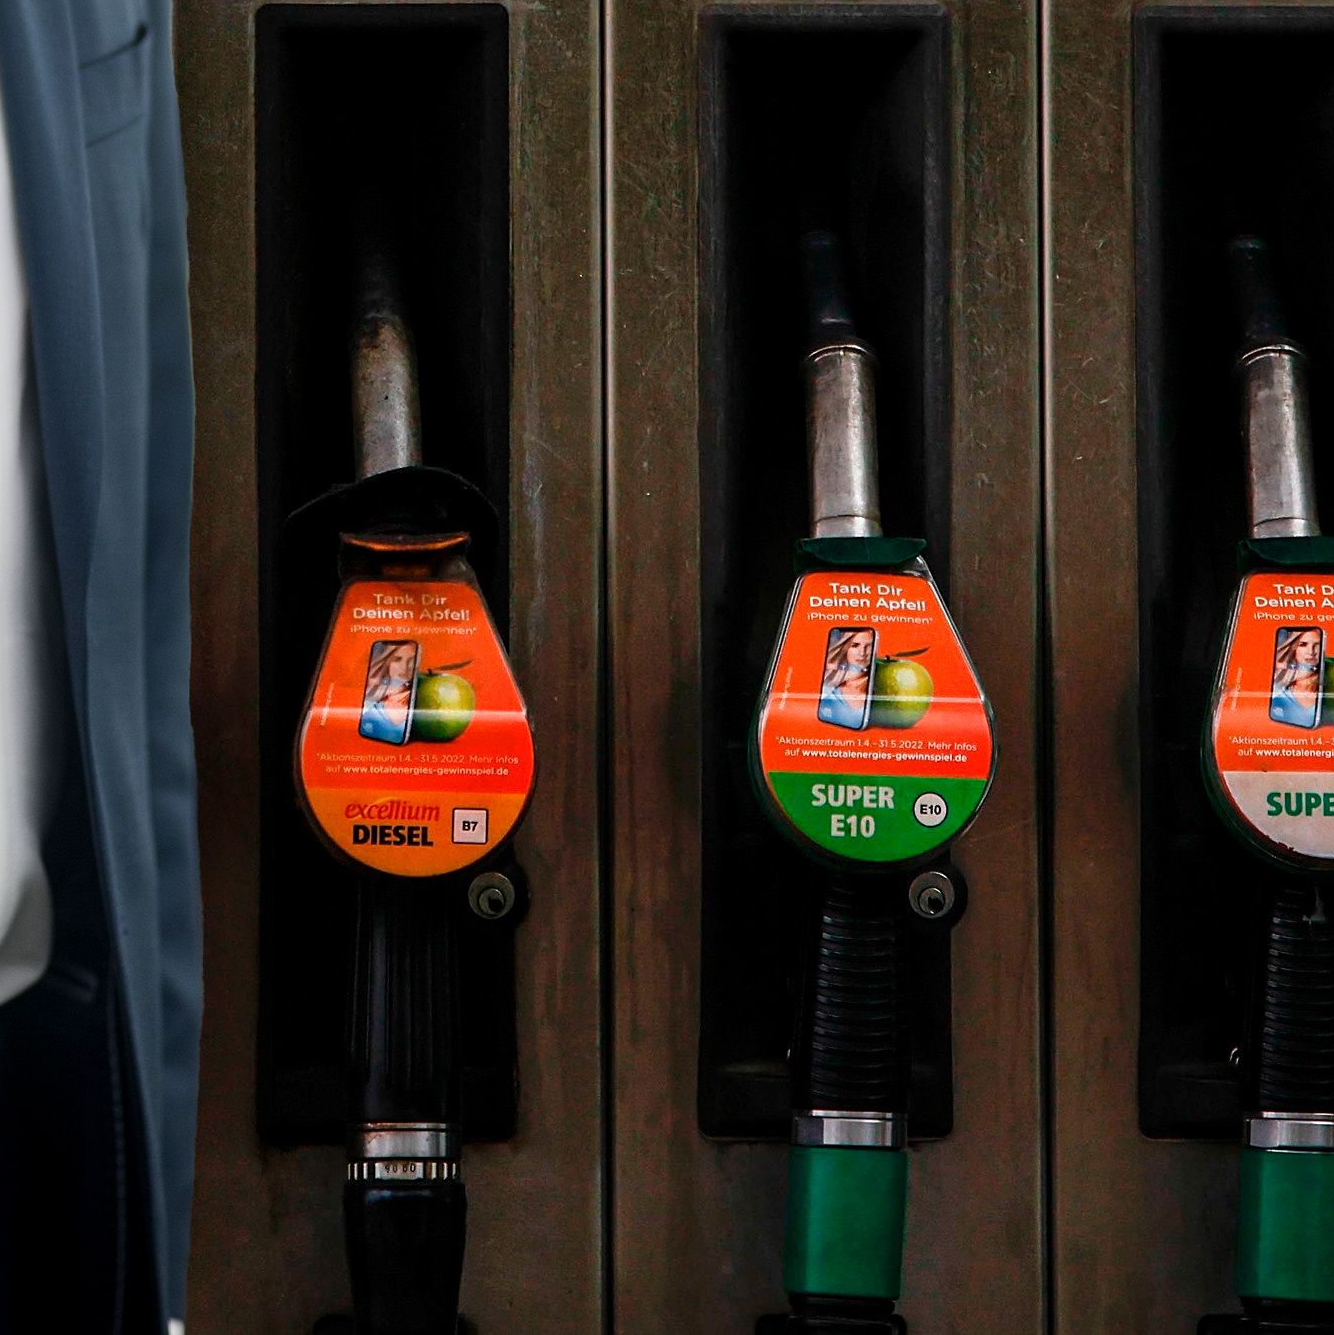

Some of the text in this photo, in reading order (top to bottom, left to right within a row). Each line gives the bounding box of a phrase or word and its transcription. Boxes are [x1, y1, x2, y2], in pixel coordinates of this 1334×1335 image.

[829, 583, 902, 596] Tank Dir
[1274, 584, 1315, 595] Tank
[373, 594, 447, 605] Tank Dir
[810, 596, 925, 612] Deinen Apfel!
[1255, 596, 1315, 608] Deinen
[353, 607, 470, 621] Deinen Apfel!
[808, 612, 849, 621] iPhone
[1254, 612, 1295, 620] iPhone
[928, 741, 952, 750] Mehr
[954, 742, 977, 751] Infos
[785, 748, 967, 763] auf www.totalenergies-gewinnspiel.de
[1238, 748, 1252, 756] auf
[343, 765, 509, 776] www.totalenergies-gewinnspiel.de
[812, 784, 894, 808] SUPER
[345, 800, 440, 822] excellium
[920, 804, 941, 815] E10
[462, 821, 478, 831] B7
[831, 815, 875, 837] E10
[353, 824, 434, 846] DIESEL
